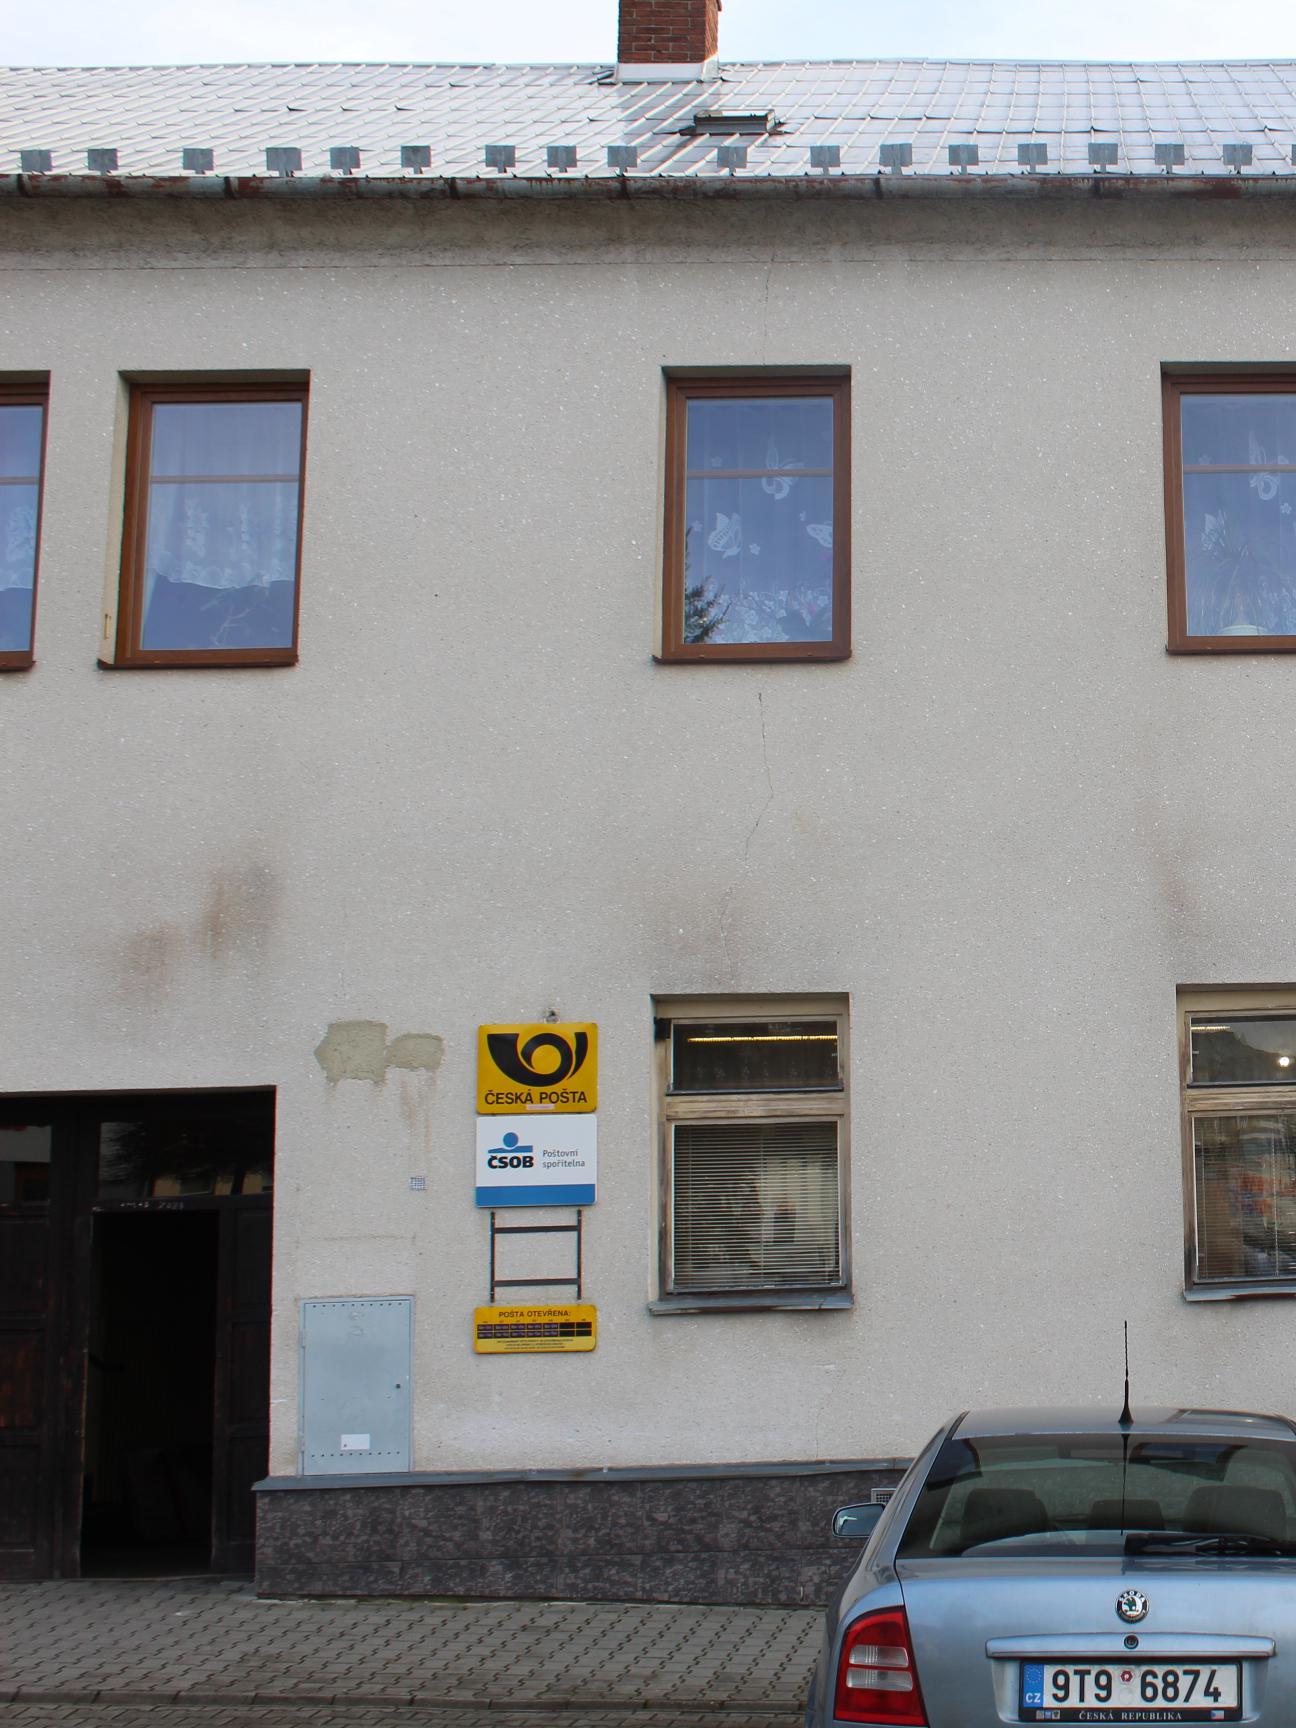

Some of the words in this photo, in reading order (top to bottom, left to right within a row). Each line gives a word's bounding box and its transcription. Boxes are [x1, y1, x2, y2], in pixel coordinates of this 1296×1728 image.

[485, 1090, 533, 1105] ČESKÁ
[539, 1089, 587, 1104] POŠTA
[542, 1149, 578, 1158] Poštovní
[487, 1155, 534, 1169] ČSOB
[542, 1160, 585, 1169] spořitelna
[498, 1310, 524, 1318] POŠTA
[1051, 1668, 1113, 1703] 9T9
[1140, 1668, 1222, 1703] 6874
[1025, 1692, 1041, 1703] CZ
[1079, 1709, 1114, 1720] ČESKÁ
[1121, 1711, 1183, 1720] REPUBLIKA
